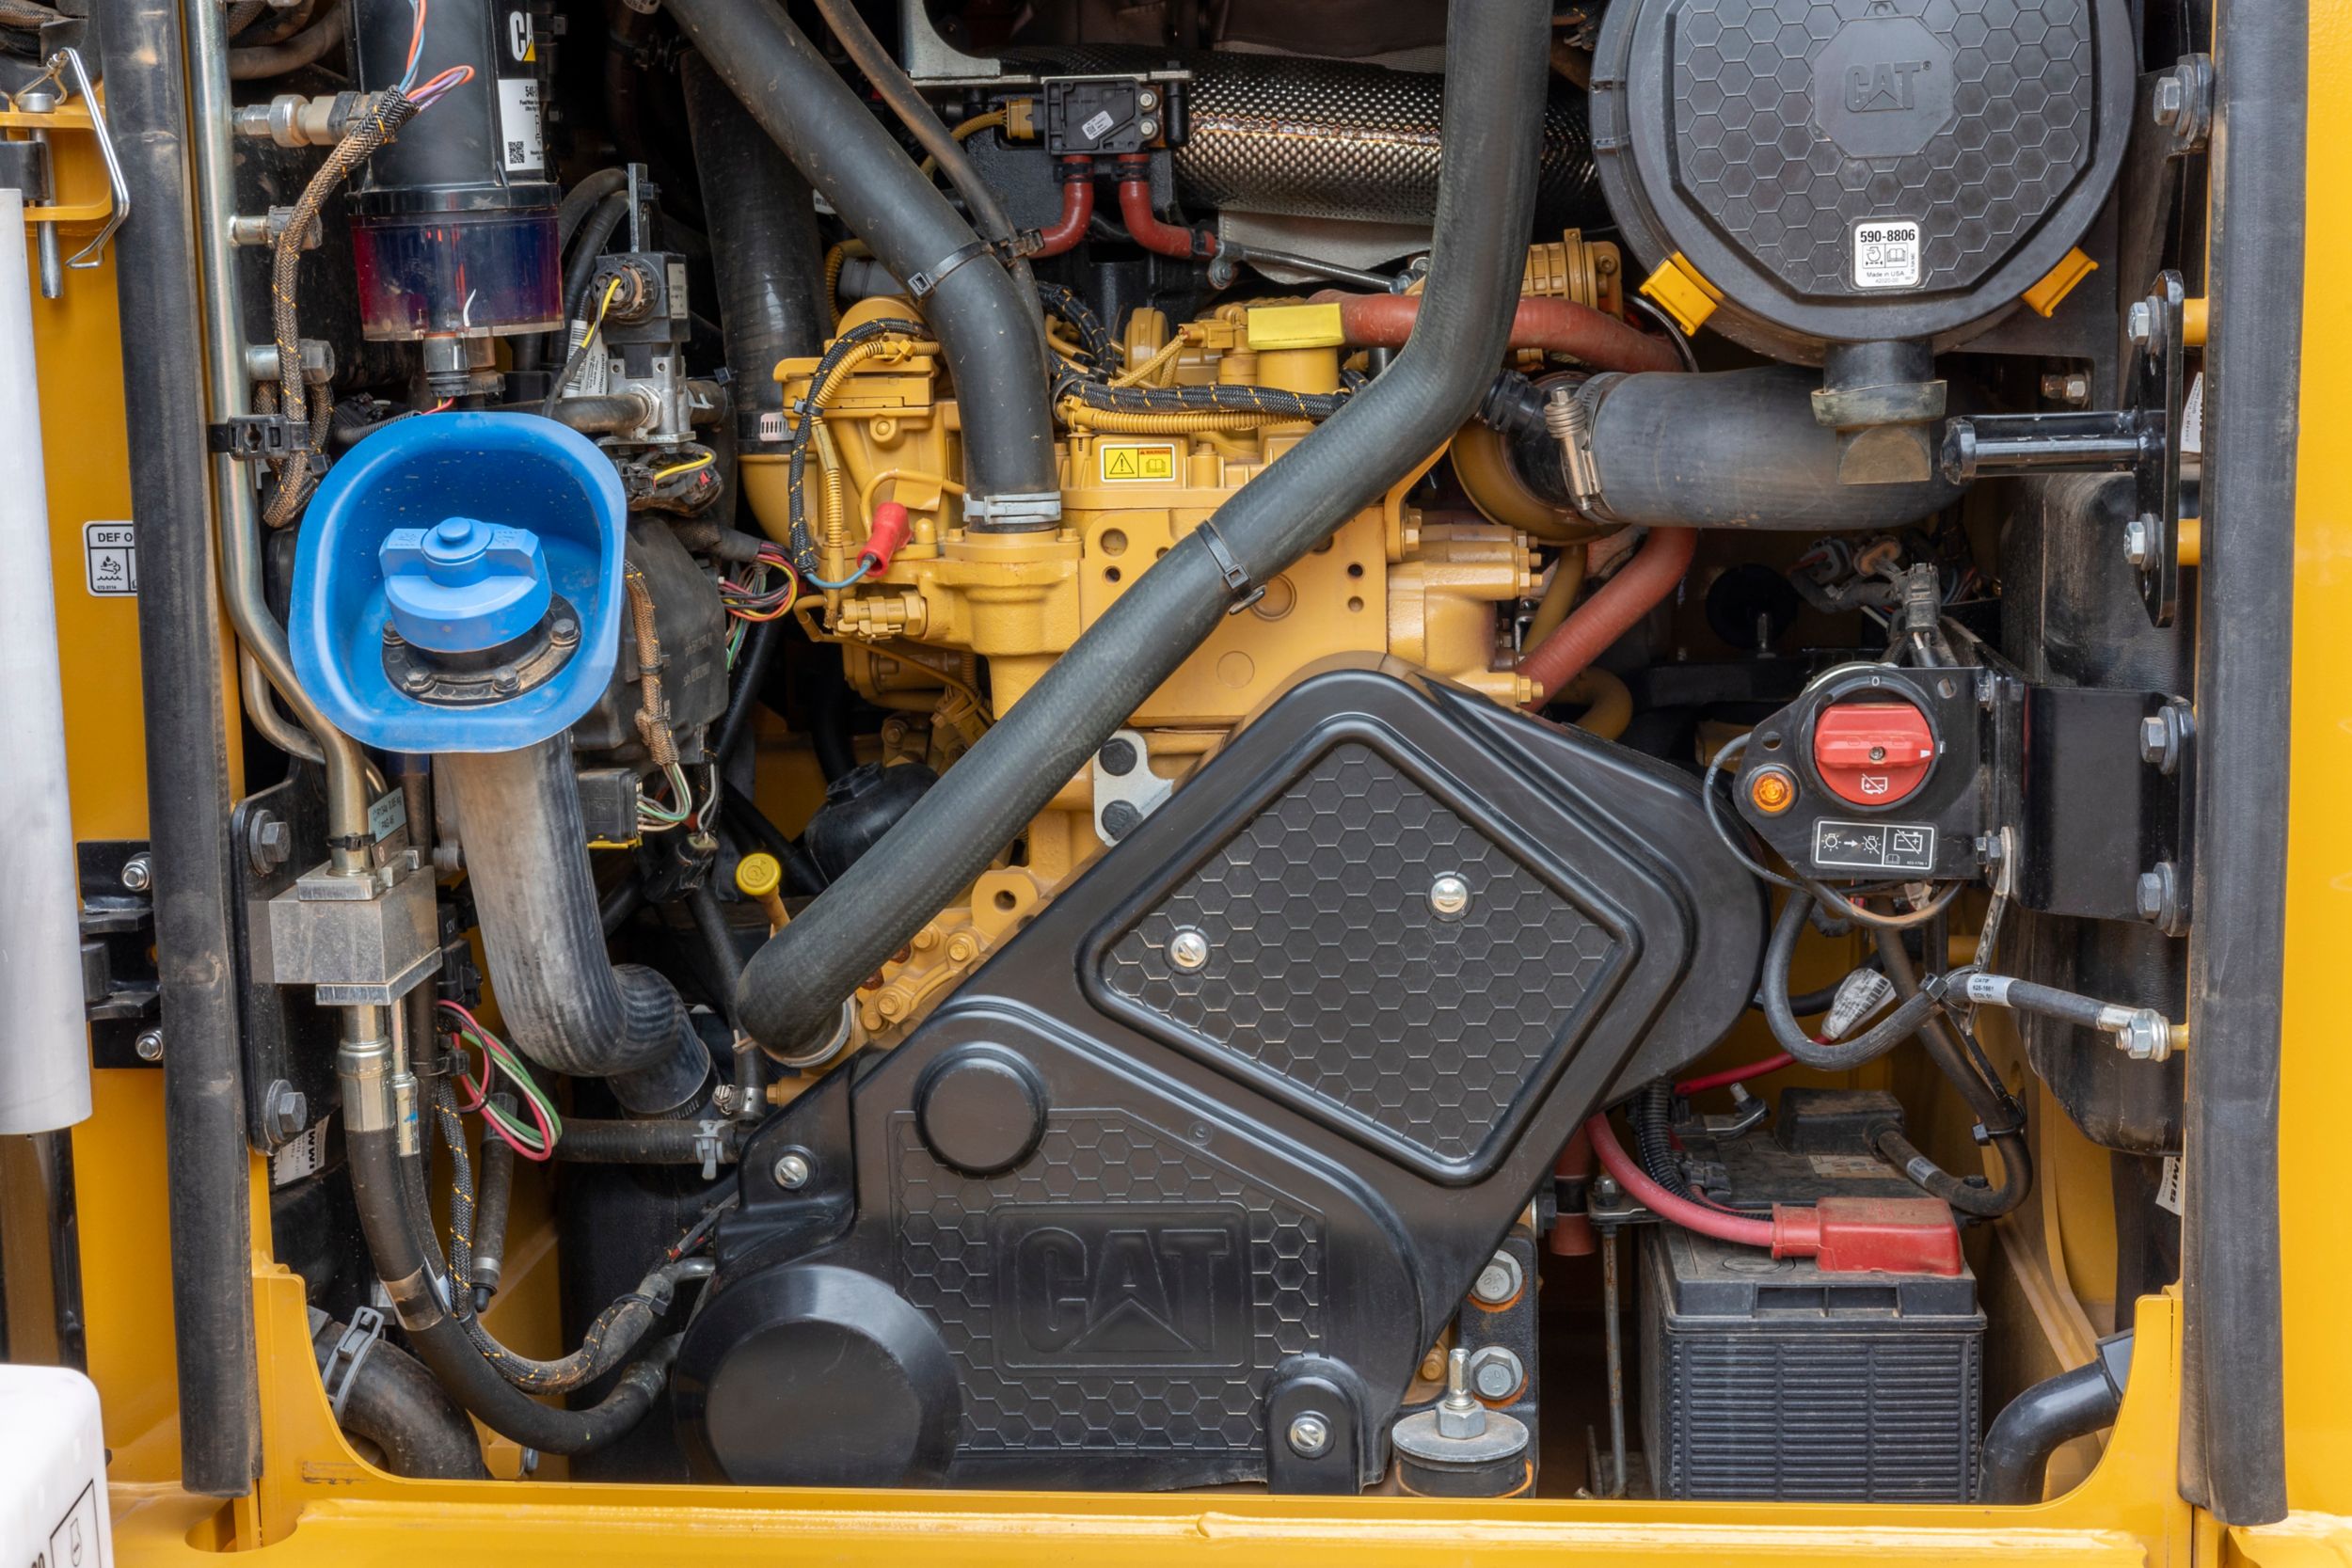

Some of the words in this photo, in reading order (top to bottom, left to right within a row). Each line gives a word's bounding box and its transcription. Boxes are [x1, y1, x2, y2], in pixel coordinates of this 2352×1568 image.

[1860, 229, 1915, 243] 590-8806
[98, 532, 120, 543] DEF
[1015, 1227, 1229, 1353] CAT
